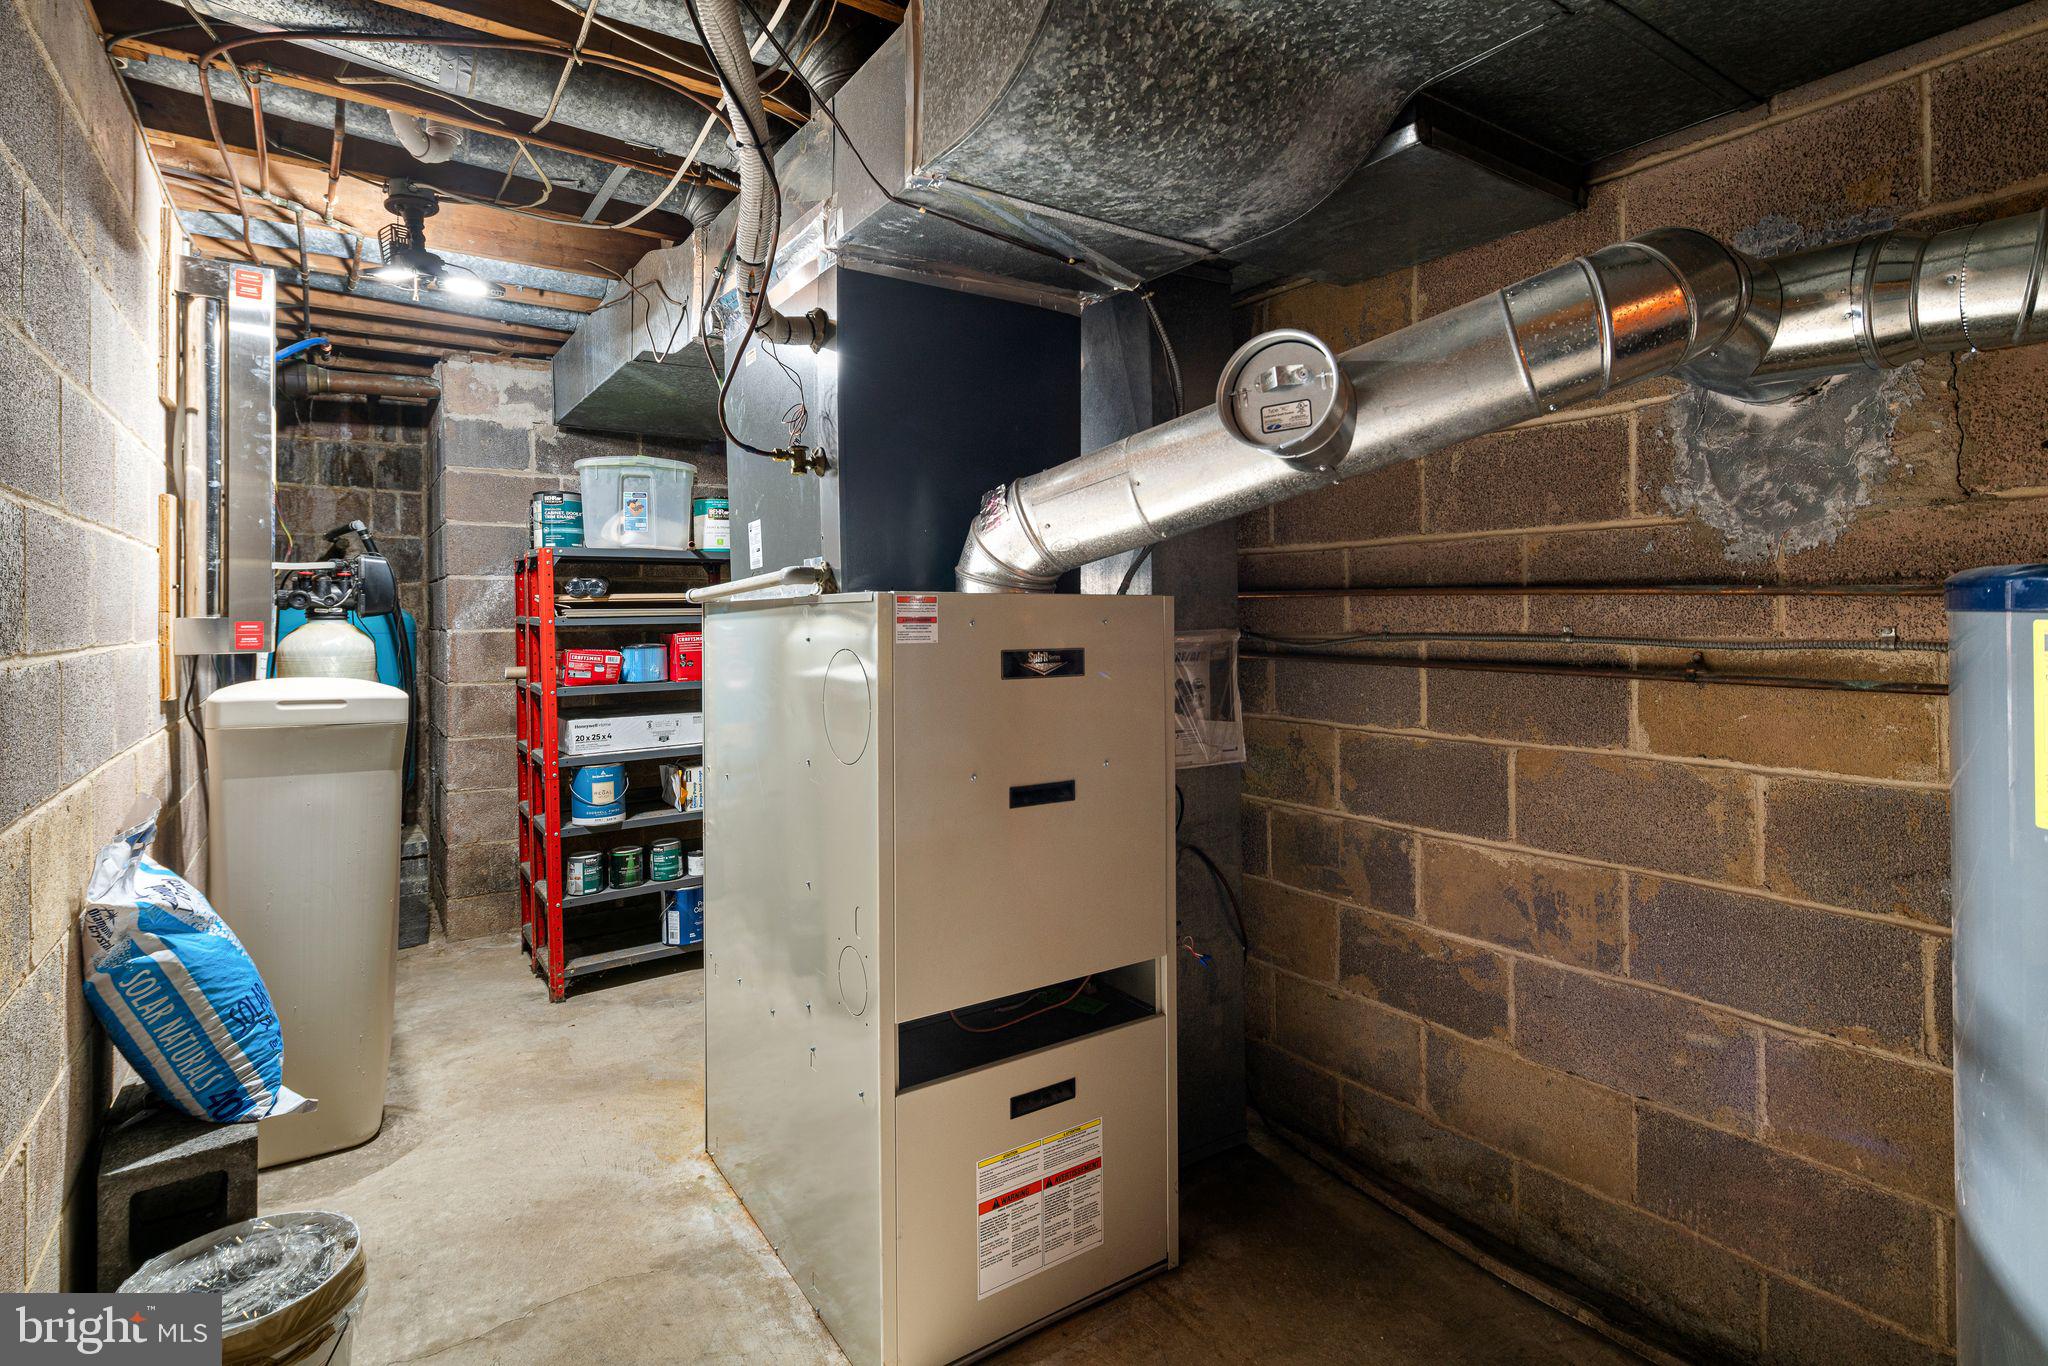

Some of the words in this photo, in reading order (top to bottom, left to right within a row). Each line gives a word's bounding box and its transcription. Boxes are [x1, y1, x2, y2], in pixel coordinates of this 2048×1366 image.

[1028, 652, 1048, 663] Spirit
[591, 733, 601, 741] 25
[607, 732, 612, 740] 4
[87, 908, 114, 939] Diamond
[88, 925, 115, 952] Crystal
[229, 982, 270, 1035] SOLAR
[119, 969, 172, 1029] SOLAR
[153, 1015, 224, 1094] NATURALS
[208, 1087, 244, 1123] 40
[1054, 1159, 1100, 1184] AVERTISSEMENT
[1001, 1188, 1030, 1205] WARNING
